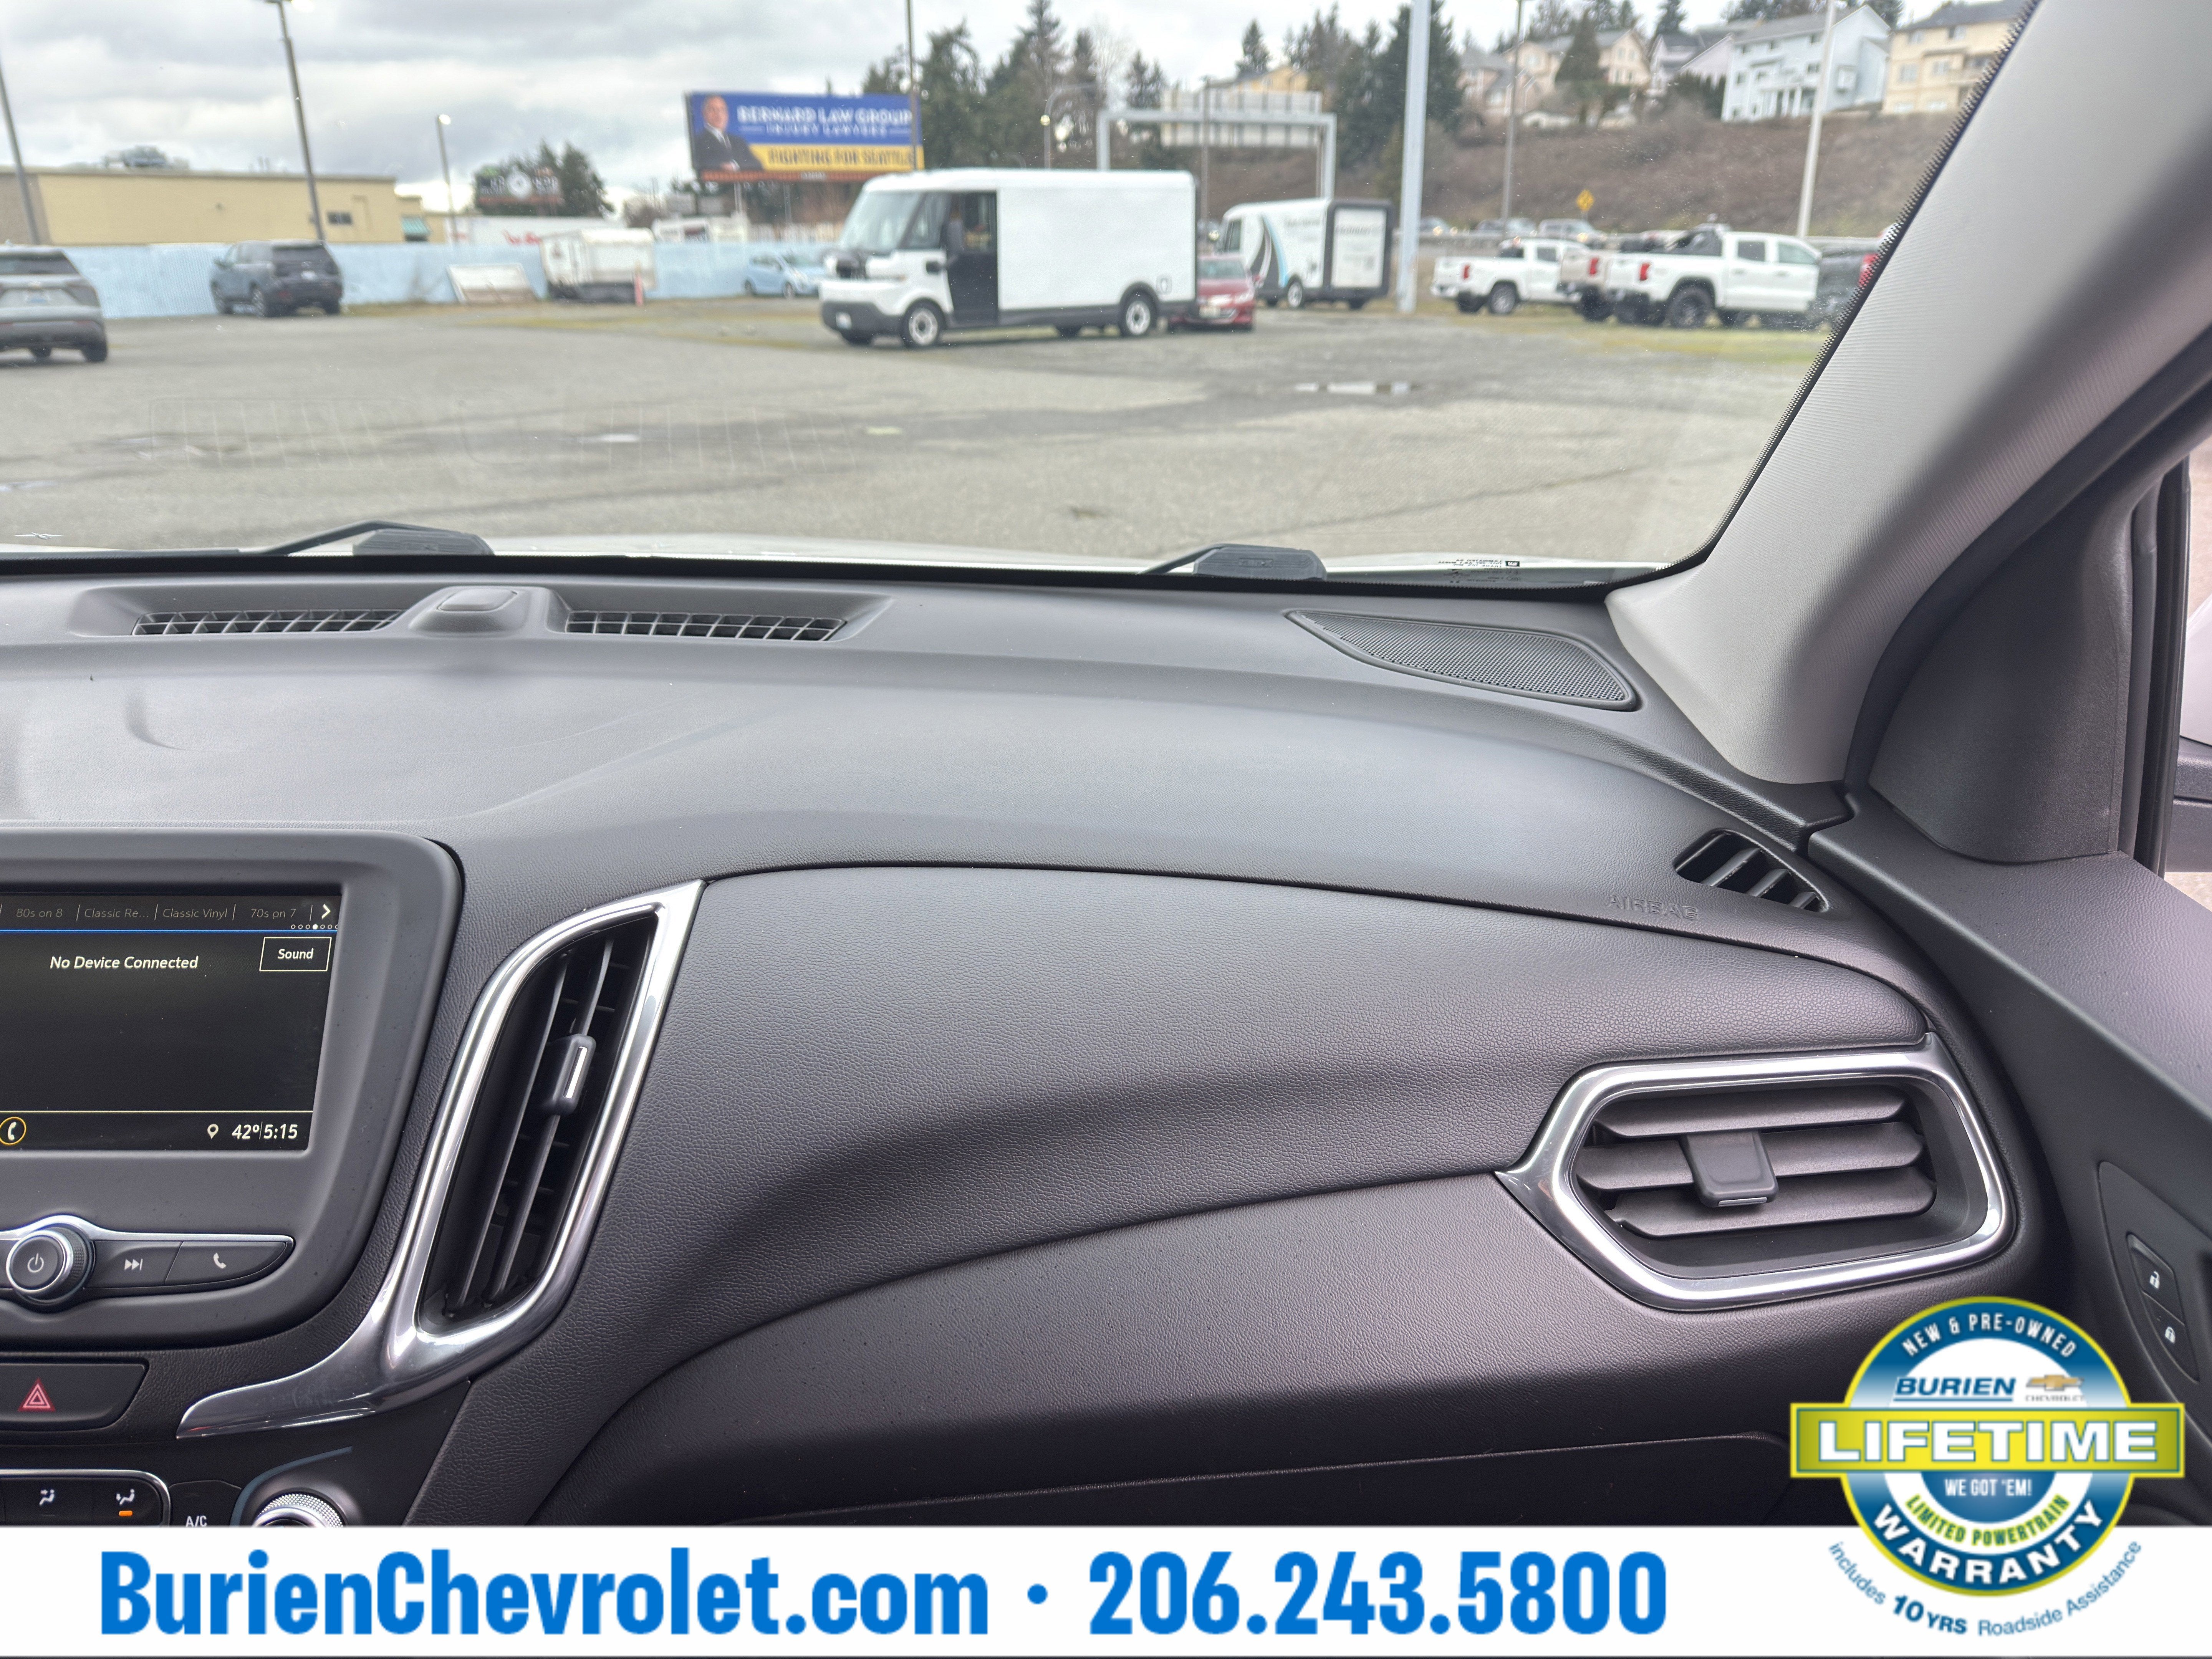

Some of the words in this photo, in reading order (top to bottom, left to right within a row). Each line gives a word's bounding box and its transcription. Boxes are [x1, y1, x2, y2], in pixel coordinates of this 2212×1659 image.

[737, 106, 817, 124] BERNARD
[818, 107, 854, 124] LAW
[854, 107, 913, 125] GROUP
[16, 908, 35, 917] 80s
[56, 908, 63, 917] 8
[84, 908, 121, 918] Classic
[251, 908, 269, 918] 70s
[290, 909, 296, 917] 7
[1607, 895, 1698, 920] AIRBAG
[163, 908, 199, 918] Classic
[203, 908, 228, 920] Vinyl
[278, 948, 314, 960] Sound
[50, 956, 70, 969] No
[74, 956, 120, 969] Device
[124, 955, 199, 969] Connected
[263, 1124, 298, 1139] 5:15
[185, 1515, 207, 1528] A/C
